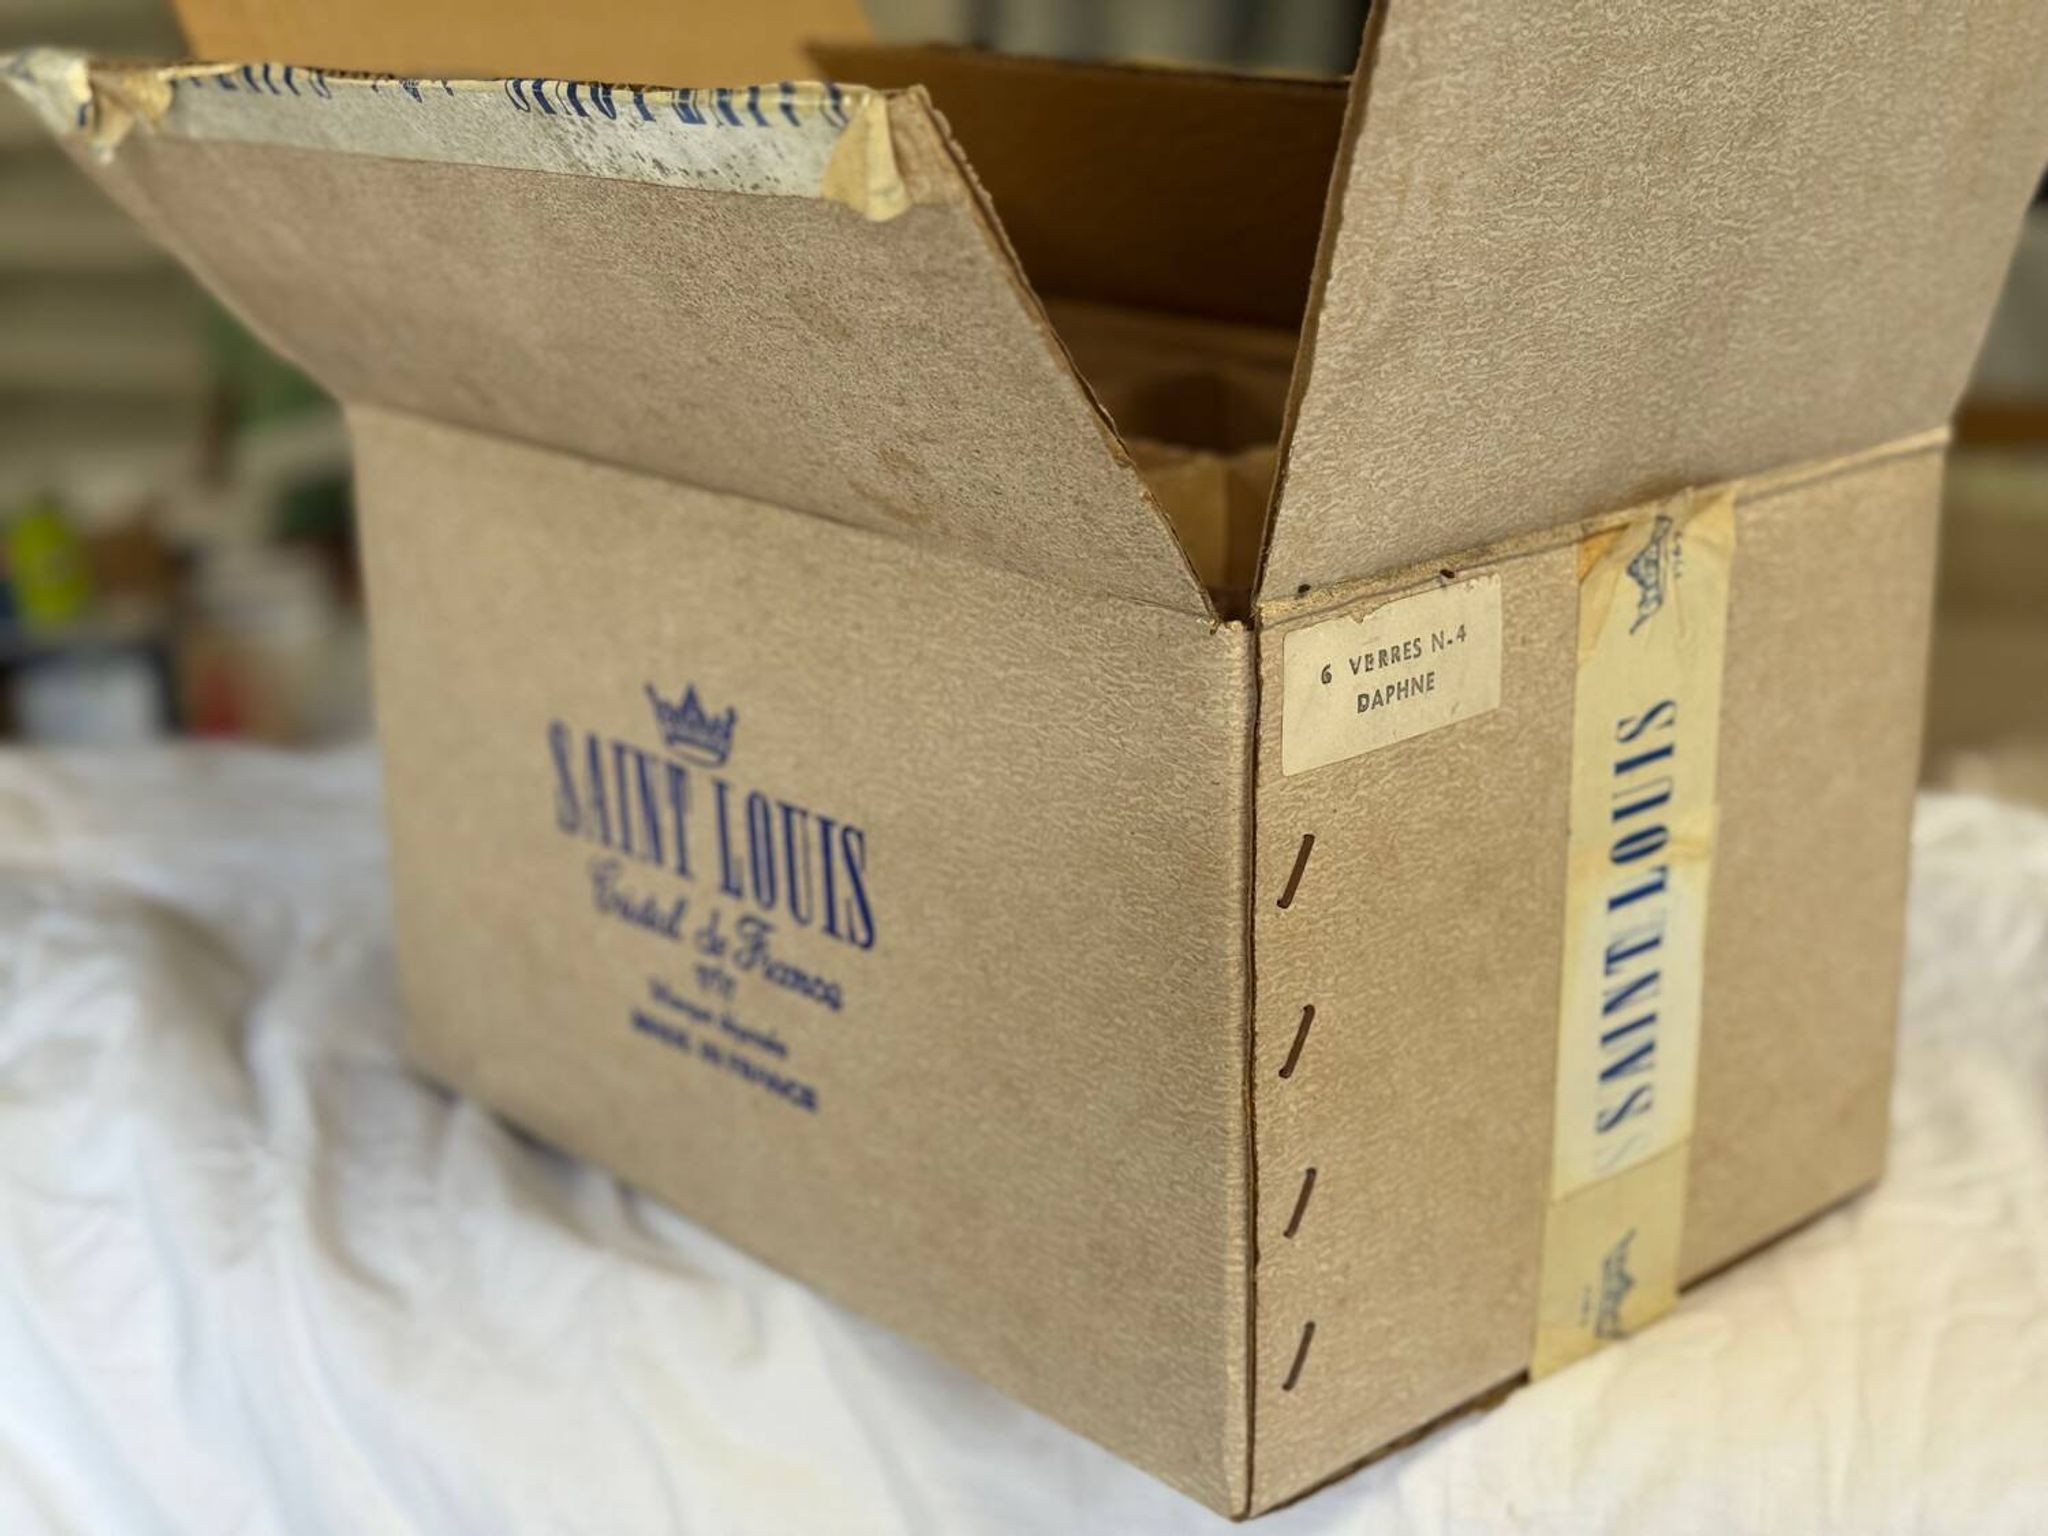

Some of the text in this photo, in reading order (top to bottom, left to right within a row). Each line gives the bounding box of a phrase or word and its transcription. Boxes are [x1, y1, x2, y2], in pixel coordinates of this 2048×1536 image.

[1321, 663, 1332, 685] 6
[1349, 637, 1422, 676] VERRES
[1357, 671, 1435, 713] DAPHNE
[549, 719, 874, 951] SAINT LOUIS
[1595, 700, 1676, 1134] SAINT LOUIS
